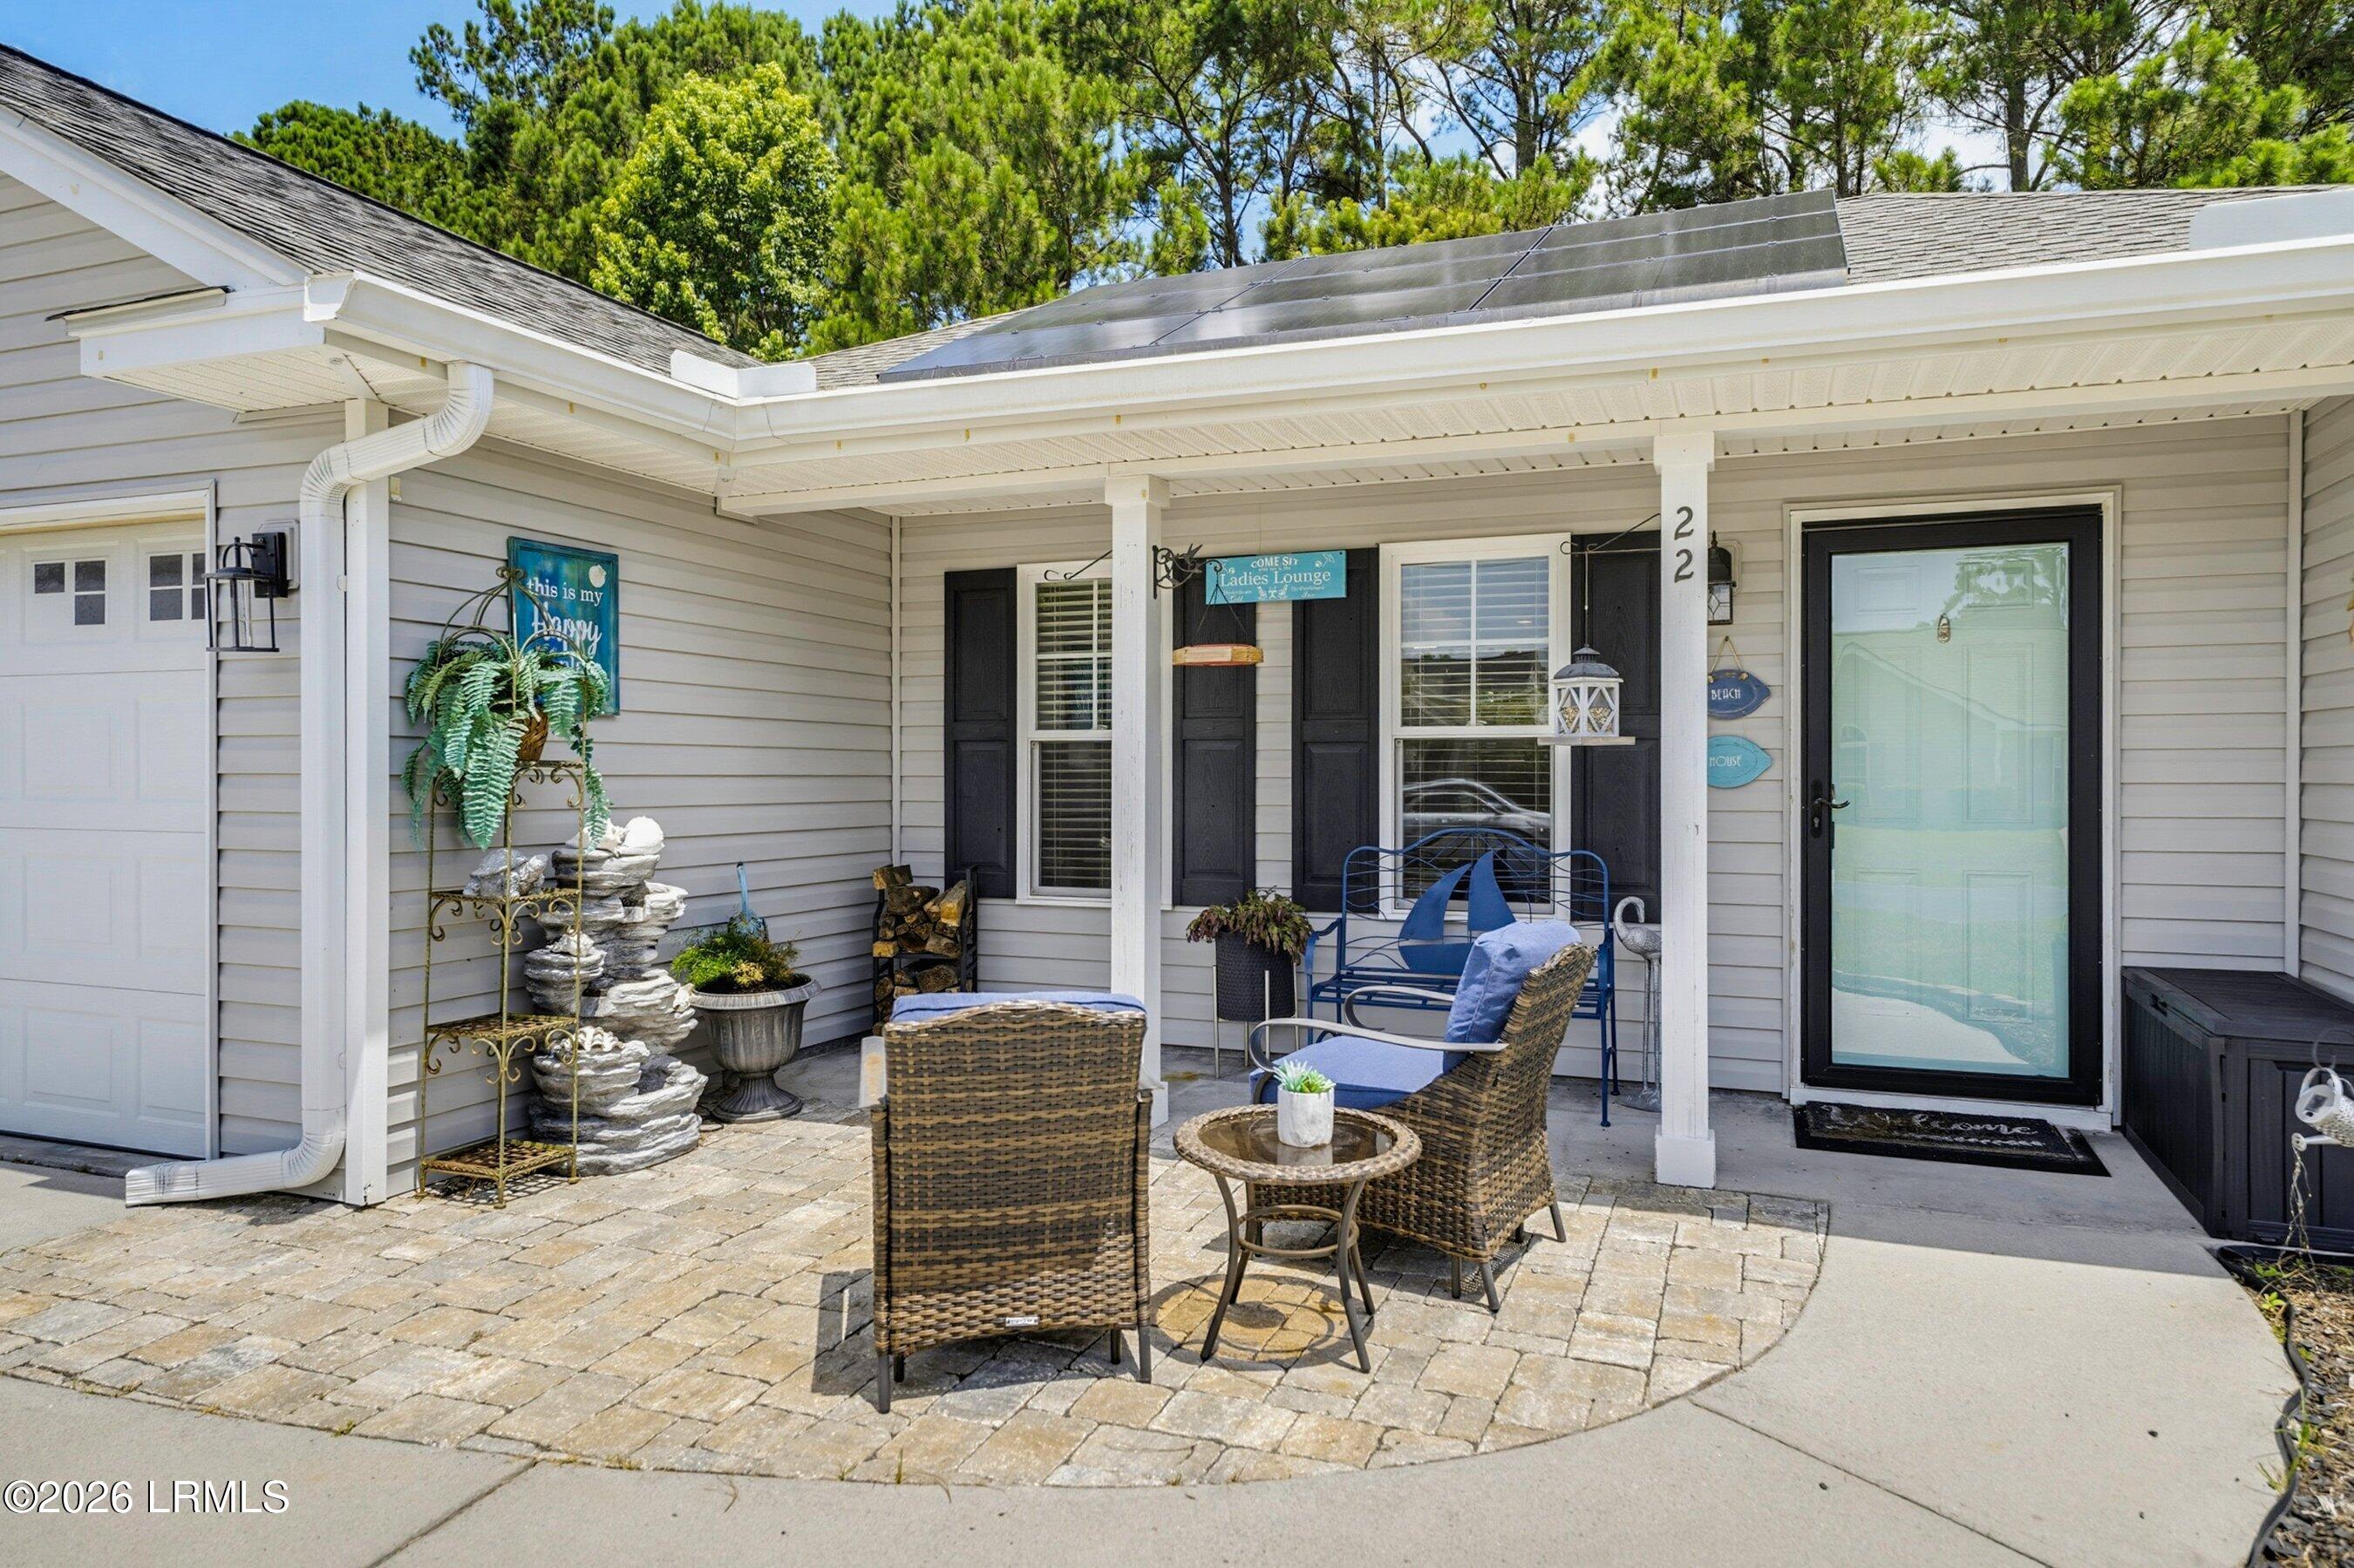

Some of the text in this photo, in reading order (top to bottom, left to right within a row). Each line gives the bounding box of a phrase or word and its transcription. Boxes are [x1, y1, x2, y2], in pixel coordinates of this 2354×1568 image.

[1674, 506, 1694, 584] 22
[1250, 556, 1280, 568] COME
[1282, 556, 1300, 567] SIT
[1220, 570, 1331, 587] Ladies Lounge
[527, 576, 603, 607] this is my
[1711, 688, 1741, 700] BEACH
[1709, 756, 1742, 767] HOUSE
